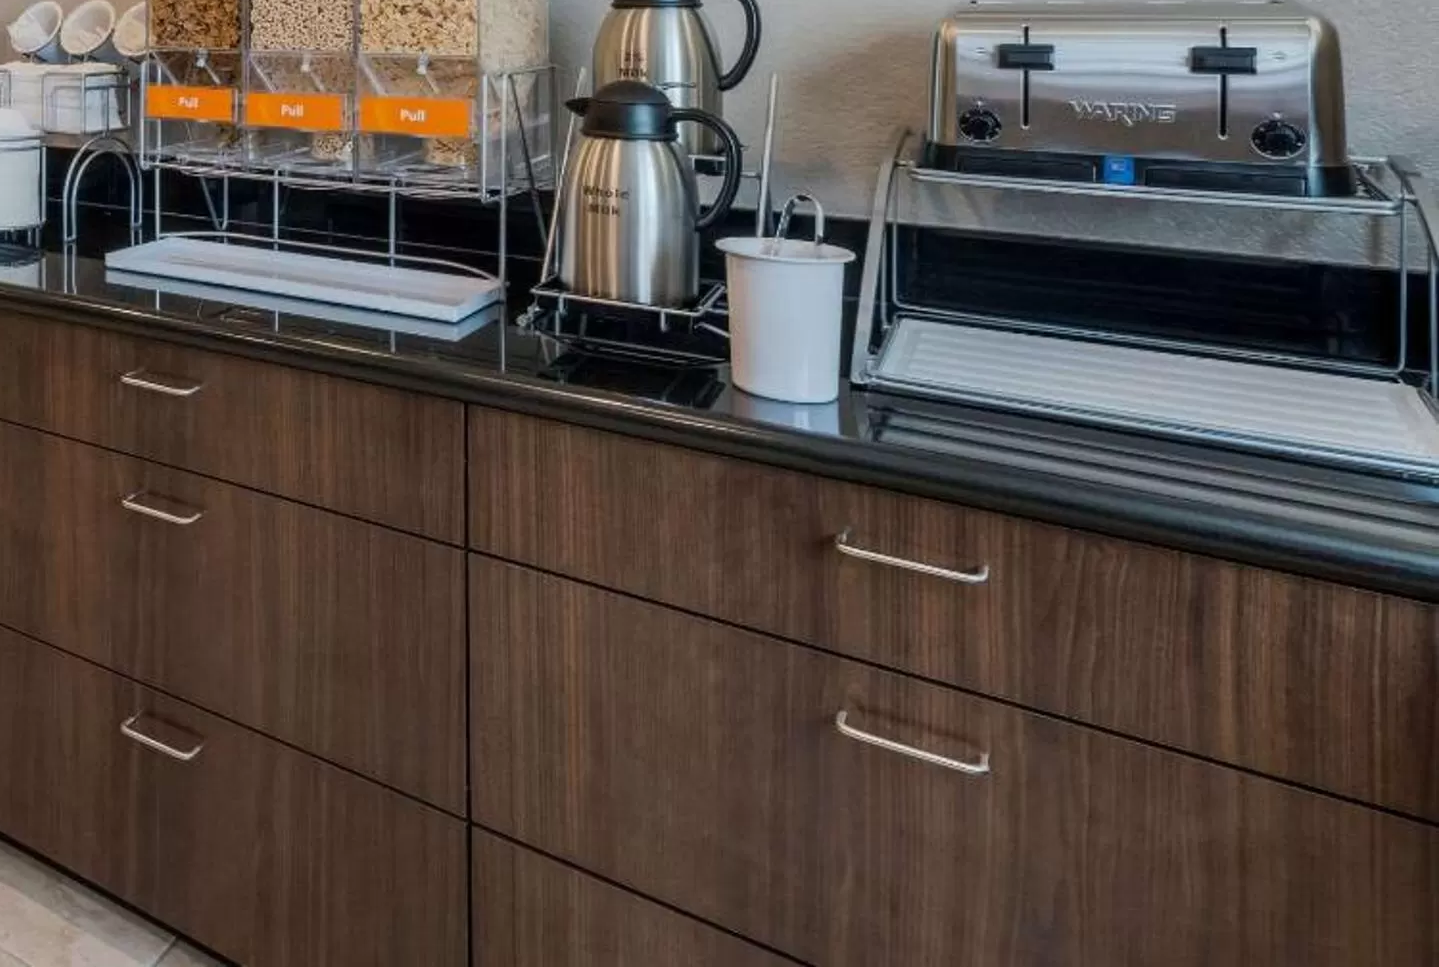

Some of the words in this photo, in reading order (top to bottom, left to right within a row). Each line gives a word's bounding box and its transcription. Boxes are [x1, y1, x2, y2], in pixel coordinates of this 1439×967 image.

[178, 96, 198, 109] Pull
[280, 102, 304, 117] Pull
[400, 108, 426, 122] Pull
[1068, 100, 1176, 126] WARING
